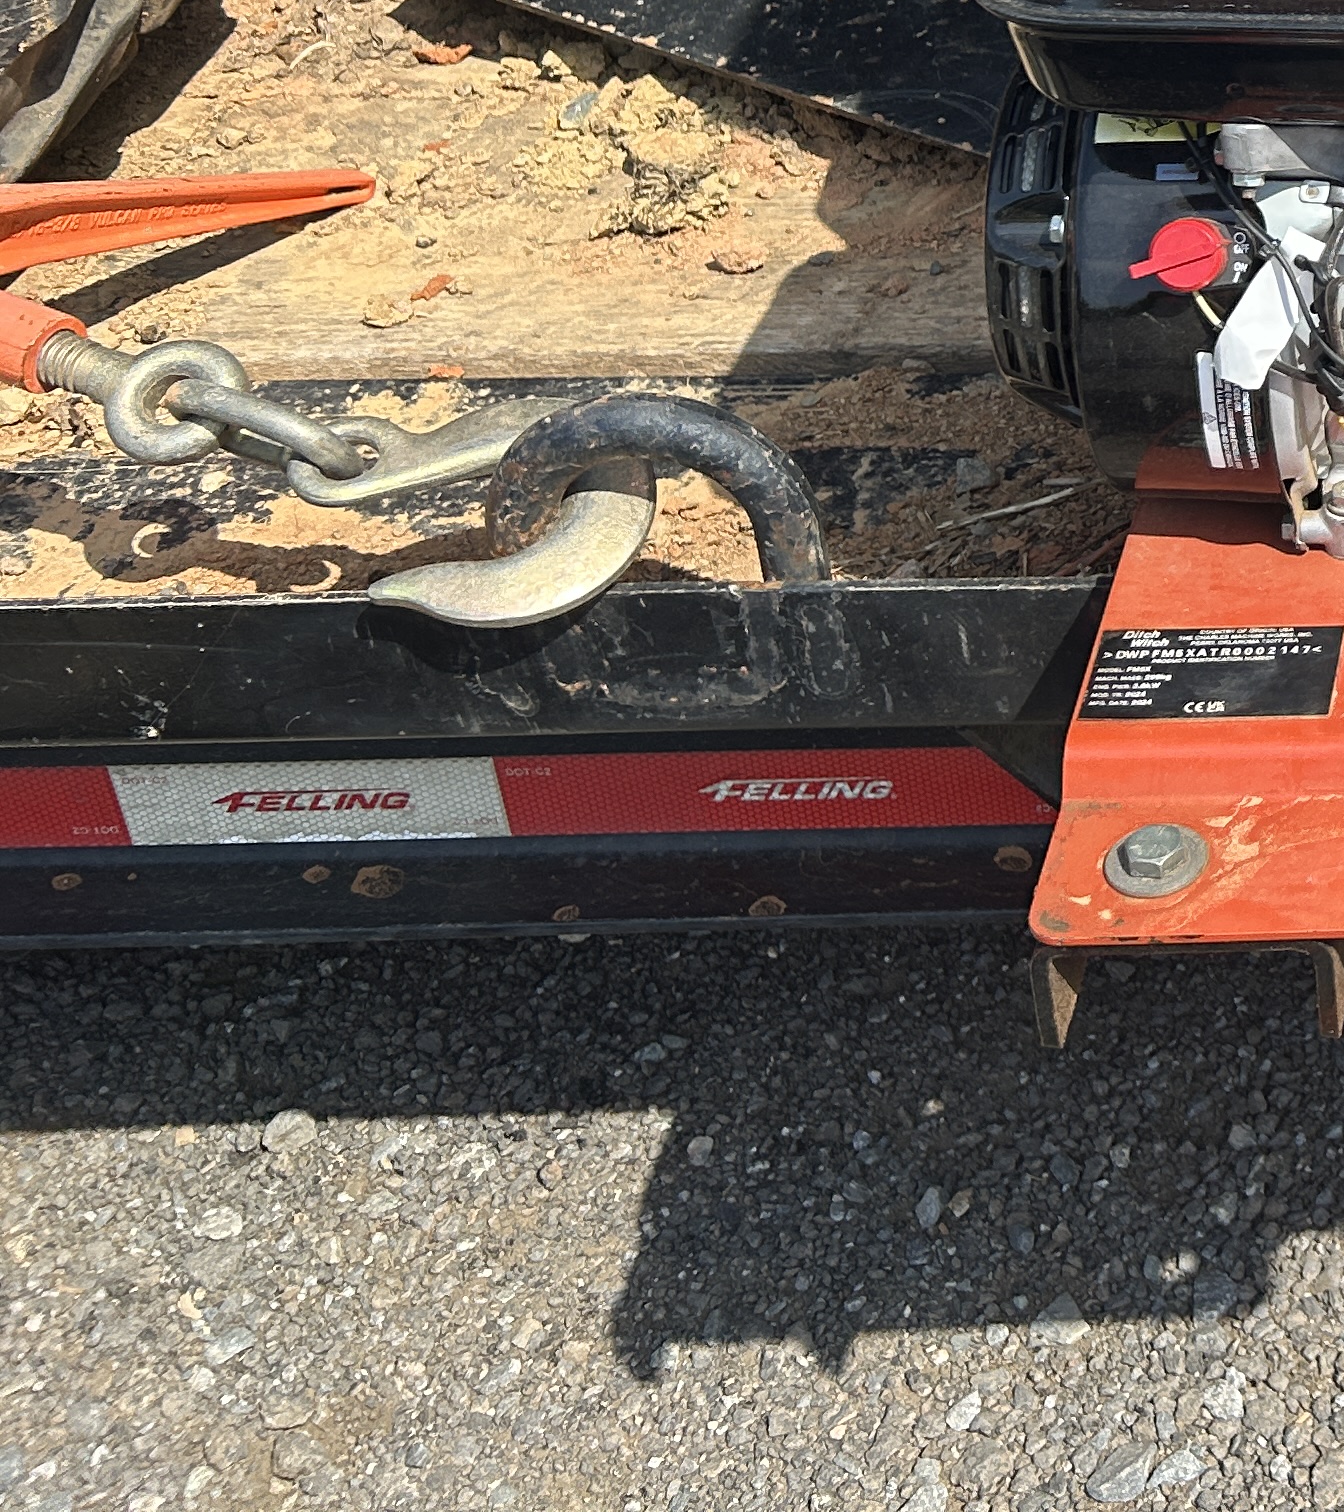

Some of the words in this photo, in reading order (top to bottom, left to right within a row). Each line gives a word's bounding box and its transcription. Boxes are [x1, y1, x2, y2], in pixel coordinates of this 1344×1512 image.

[91, 208, 142, 229] VULCAN
[1233, 262, 1249, 272] ON
[1122, 630, 1161, 640] Ditch
[1130, 638, 1170, 648] Witch
[505, 766, 552, 778] DOT-C2
[700, 777, 894, 803] FELLING
[213, 788, 411, 814] FELLING
